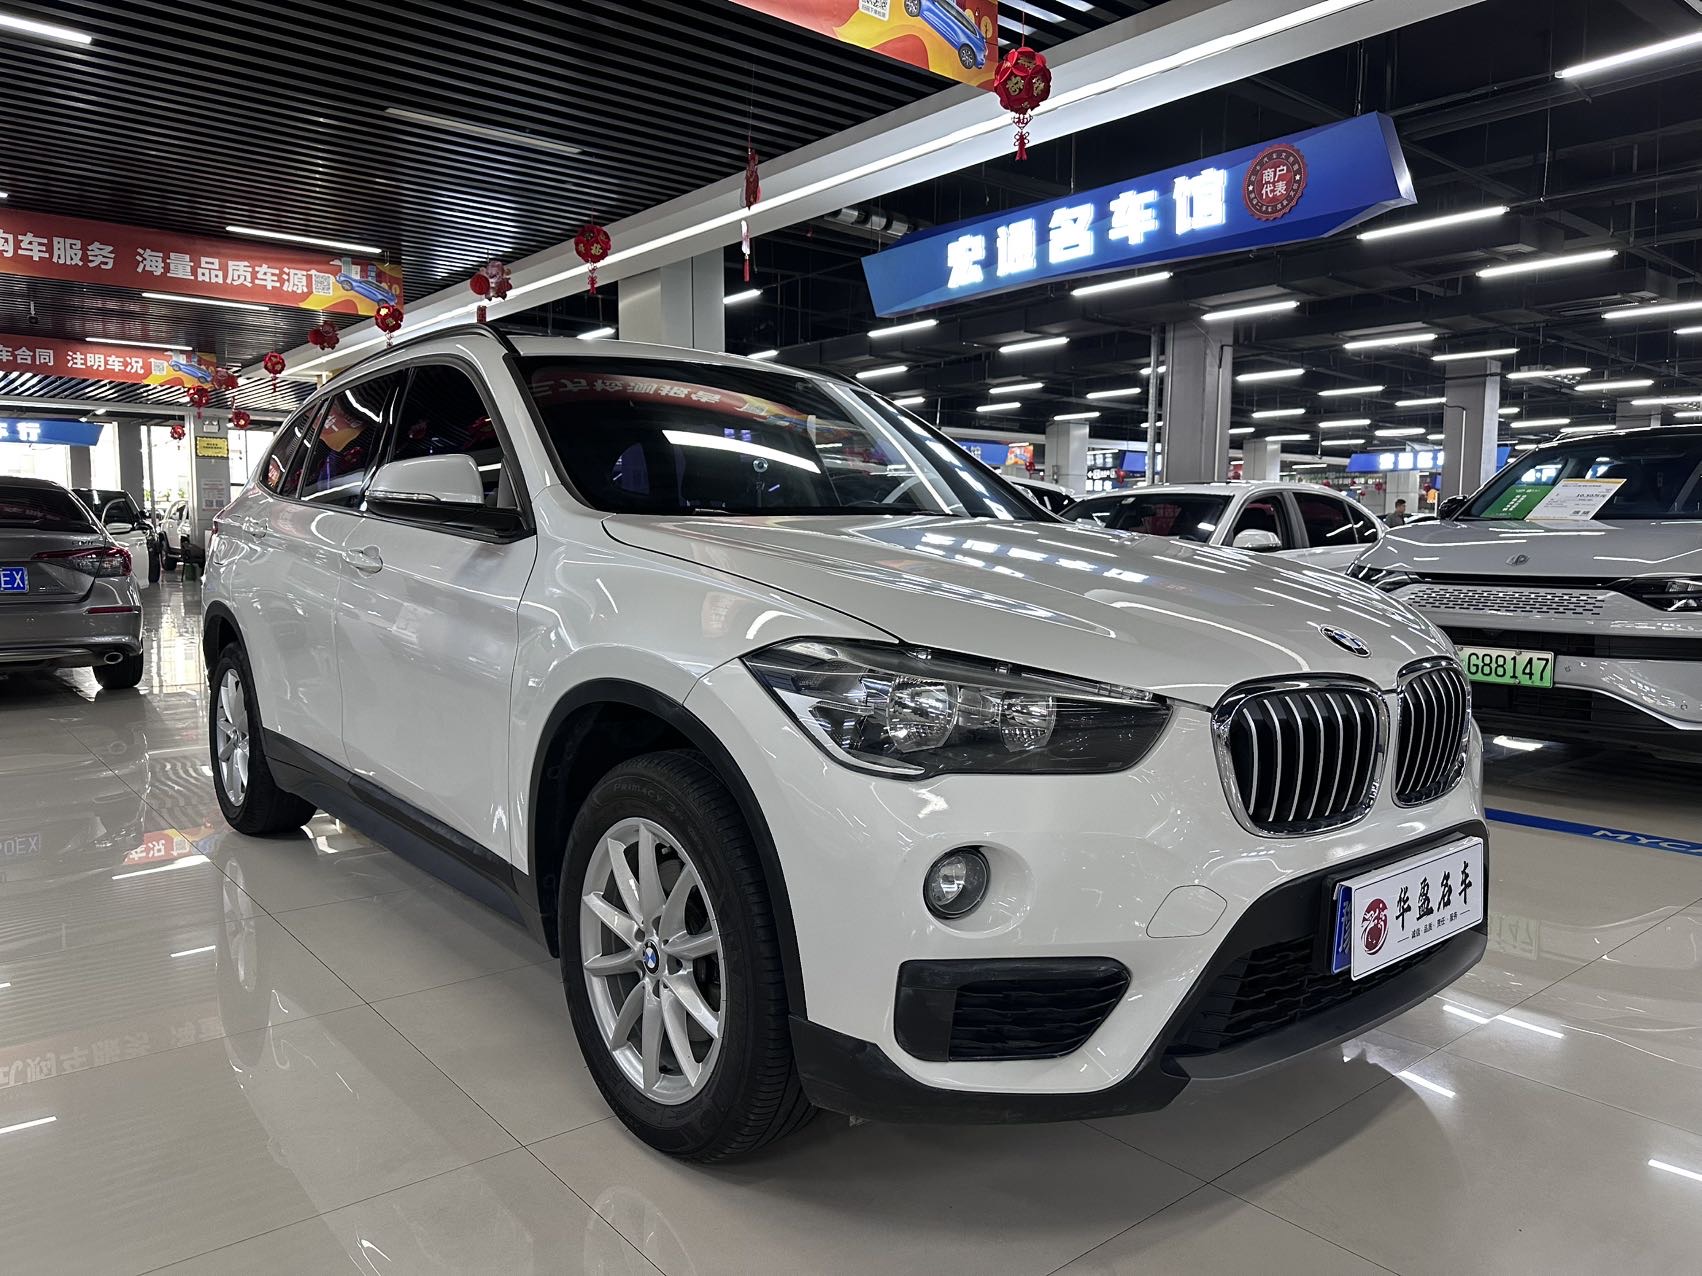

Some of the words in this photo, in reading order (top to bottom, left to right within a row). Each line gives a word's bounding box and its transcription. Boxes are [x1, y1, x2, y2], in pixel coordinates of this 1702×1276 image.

[1262, 165, 1287, 184] 商户
[1261, 181, 1287, 199] 代表
[946, 167, 1227, 289] 宏通名车馆
[135, 248, 308, 293] 海量品质车源
[66, 351, 144, 374] 注明车况
[1467, 652, 1550, 682] G88147
[1395, 860, 1473, 931] 华盈名车
